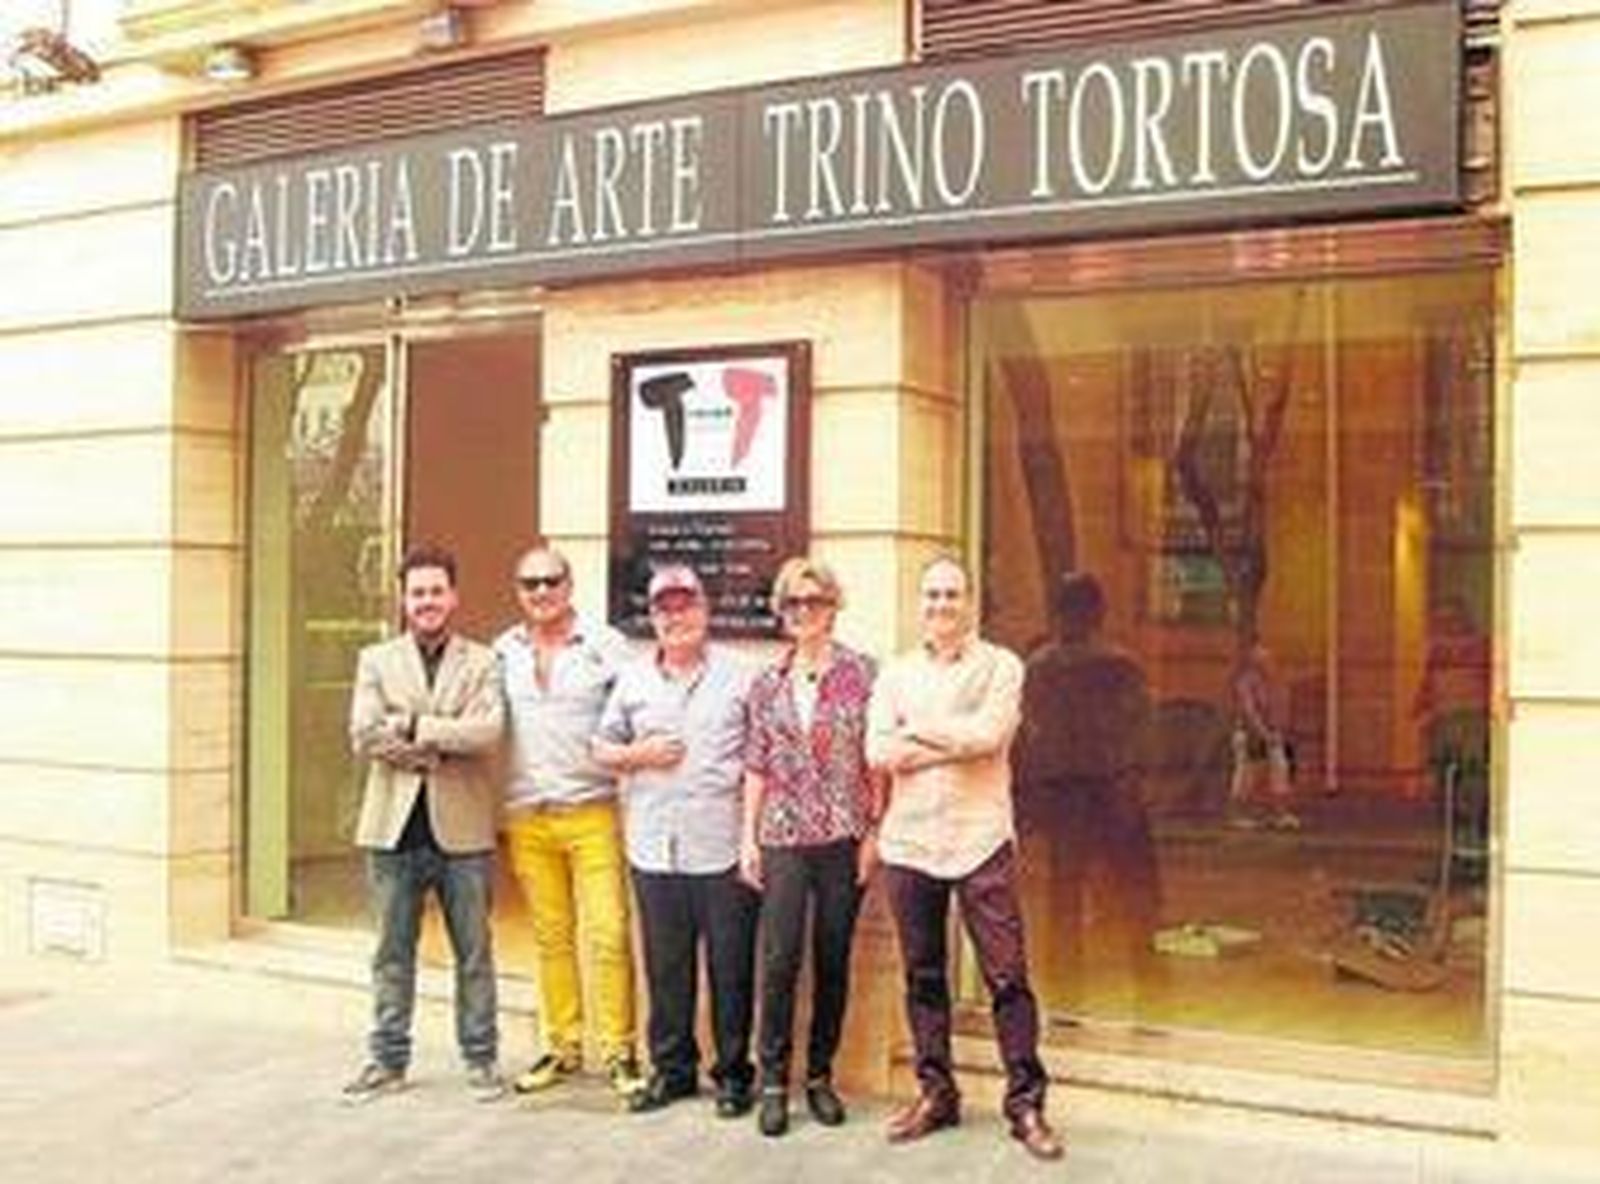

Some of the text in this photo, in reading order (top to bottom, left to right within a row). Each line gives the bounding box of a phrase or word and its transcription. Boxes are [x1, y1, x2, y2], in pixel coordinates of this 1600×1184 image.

[203, 30, 1404, 285] GALERIA DE ARTE TRINO TORTOSA
